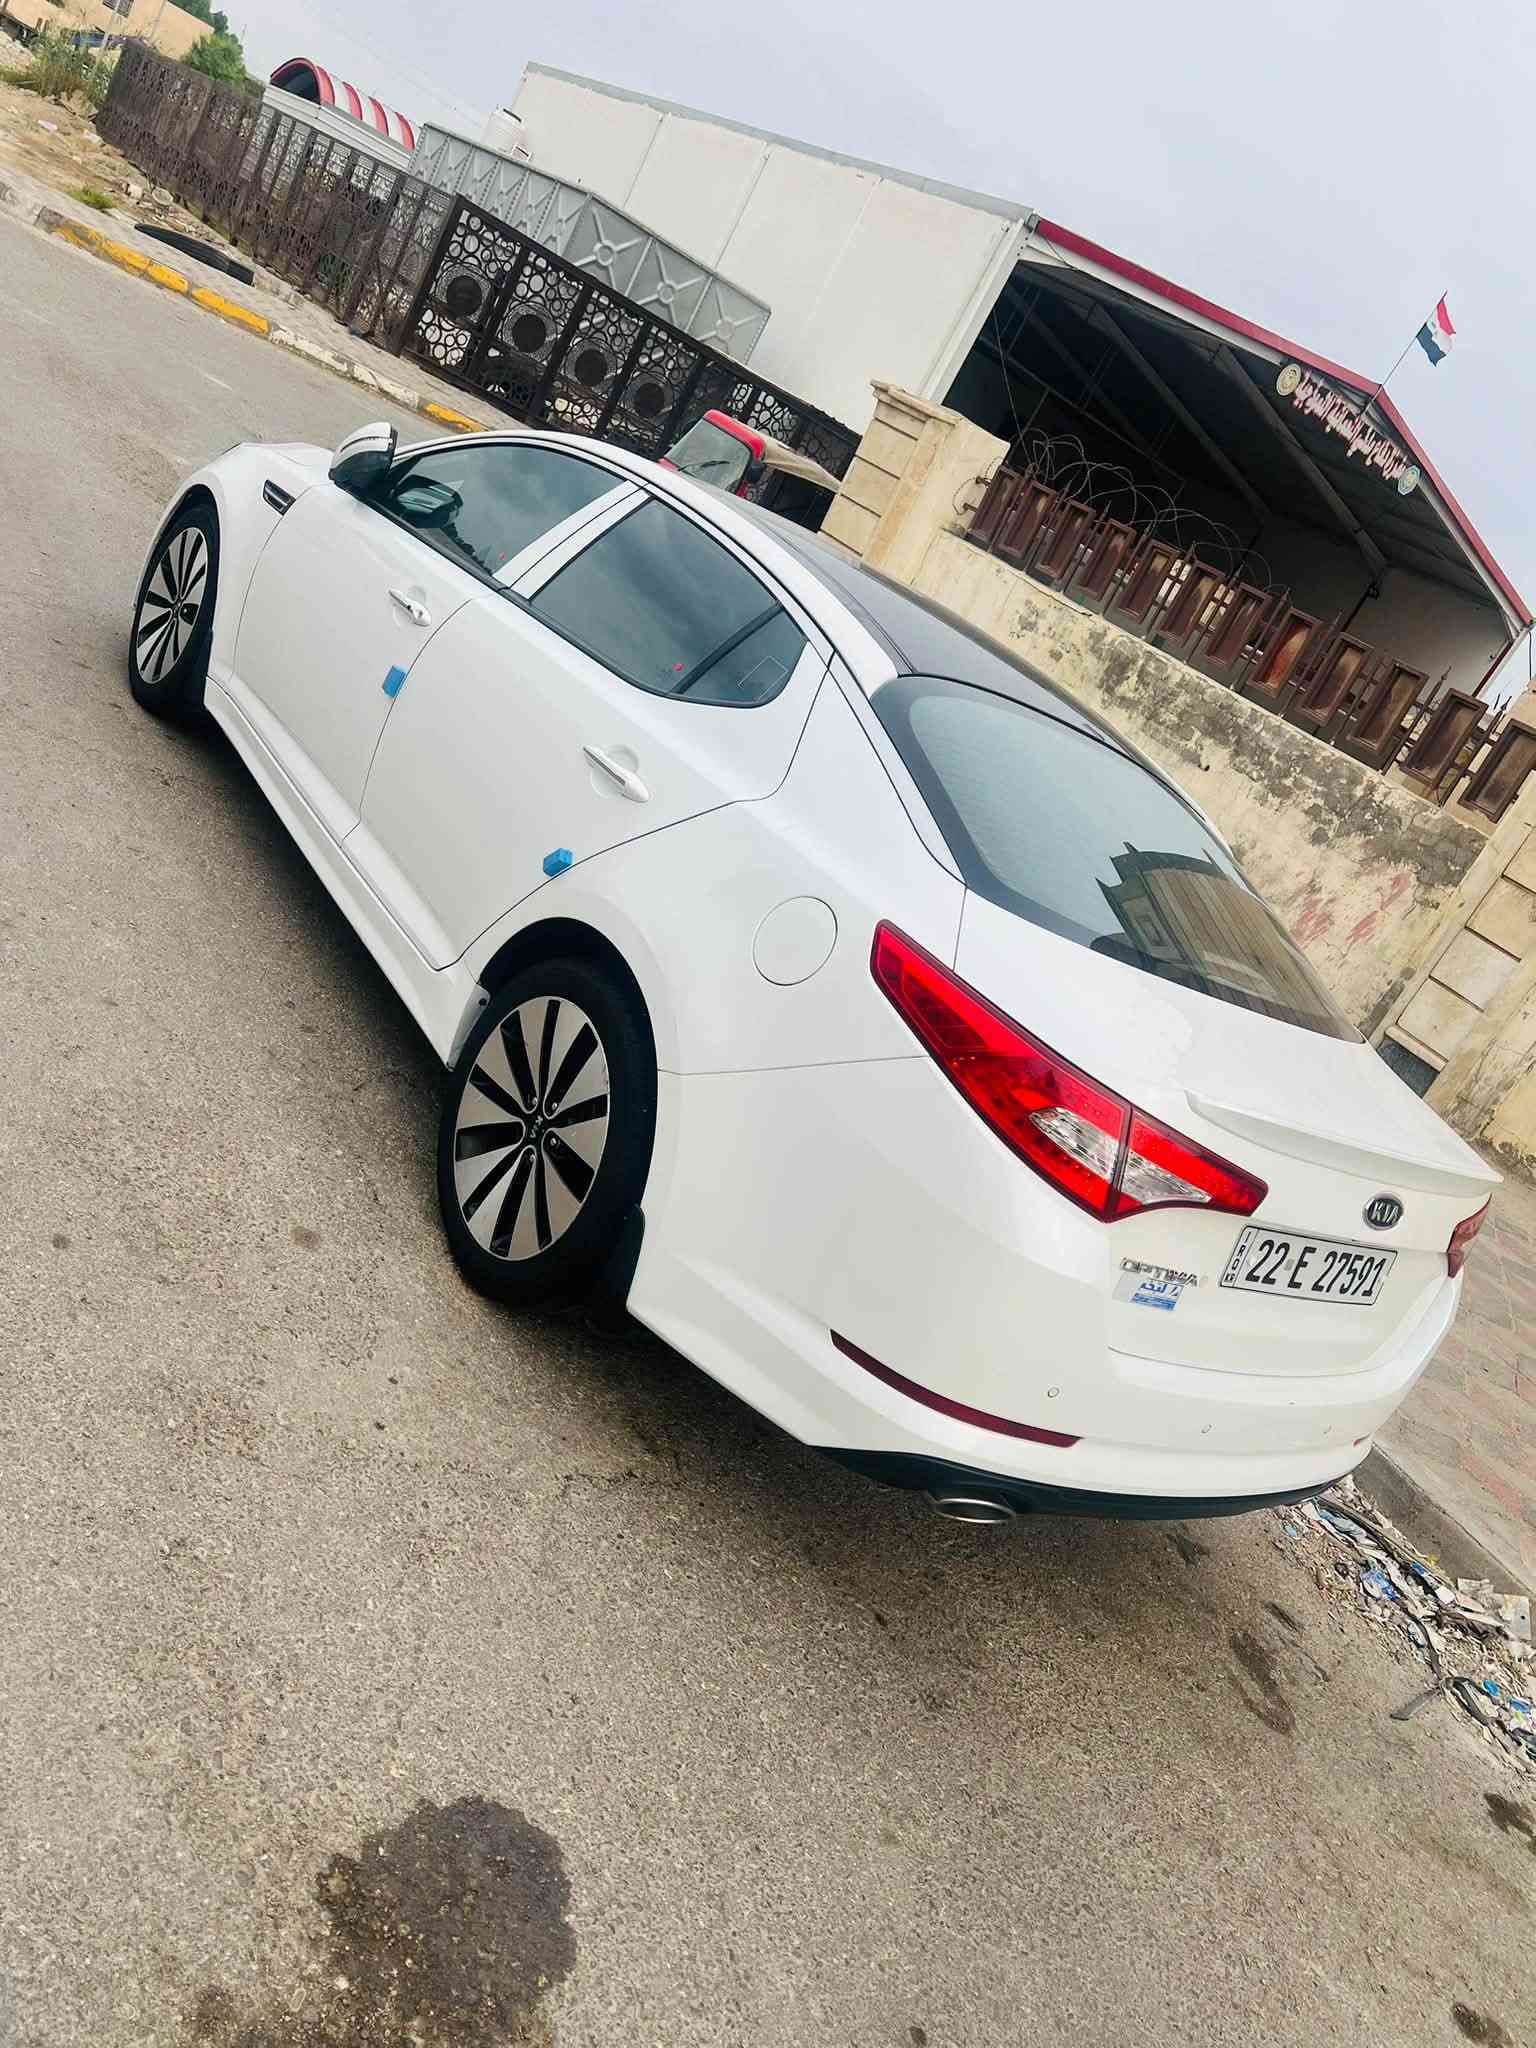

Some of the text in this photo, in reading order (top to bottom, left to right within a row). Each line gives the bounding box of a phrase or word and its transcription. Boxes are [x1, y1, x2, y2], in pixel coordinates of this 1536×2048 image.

[1370, 1200, 1399, 1225] KIA
[1245, 1239, 1387, 1297] 22 E 27591
